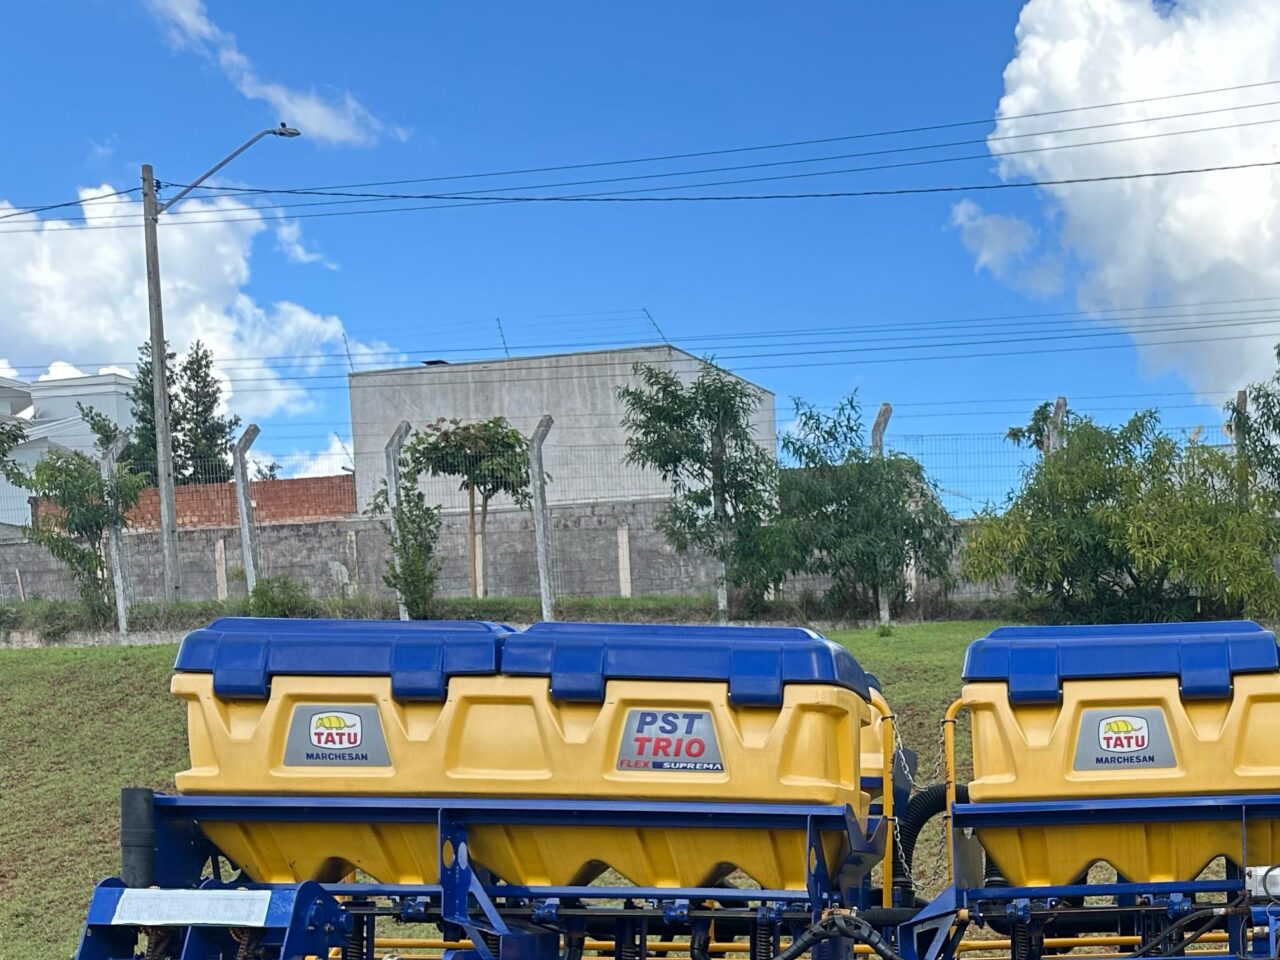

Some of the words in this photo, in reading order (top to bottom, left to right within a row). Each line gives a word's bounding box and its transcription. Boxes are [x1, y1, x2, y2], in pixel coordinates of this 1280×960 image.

[636, 712, 704, 735] PST
[314, 732, 358, 745] TATU
[1103, 735, 1145, 749] TATU
[634, 736, 706, 758] TRIO
[305, 752, 368, 761] MARCHESAN
[1095, 755, 1155, 765] MARCHESAN
[619, 759, 650, 769] FLEX
[662, 762, 722, 770] SUPREMA
